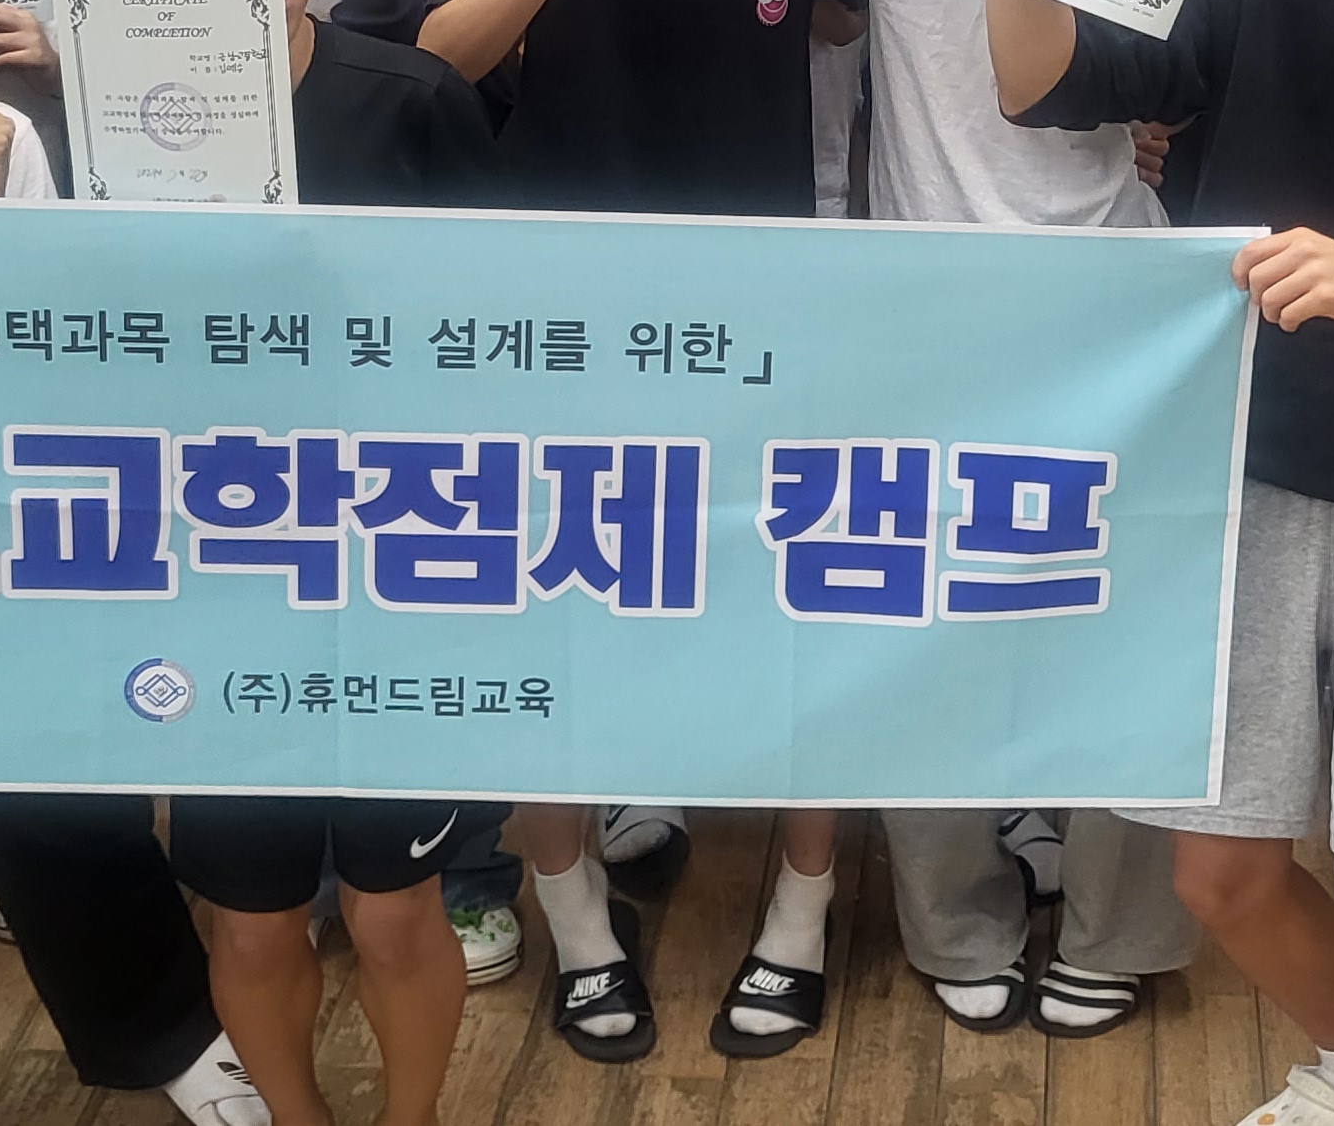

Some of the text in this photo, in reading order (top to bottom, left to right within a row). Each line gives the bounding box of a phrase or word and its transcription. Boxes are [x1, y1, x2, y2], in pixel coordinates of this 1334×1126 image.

[157, 11, 176, 22] OF
[125, 27, 213, 39] COMPLETION
[204, 313, 312, 367] 탐색
[345, 315, 394, 369] 및
[427, 316, 592, 374] 설계를
[763, 440, 1115, 616] 캠프
[222, 670, 556, 720] (주)휴먼드림교육
[572, 971, 611, 999] NIKE
[749, 966, 795, 992] NIKE
